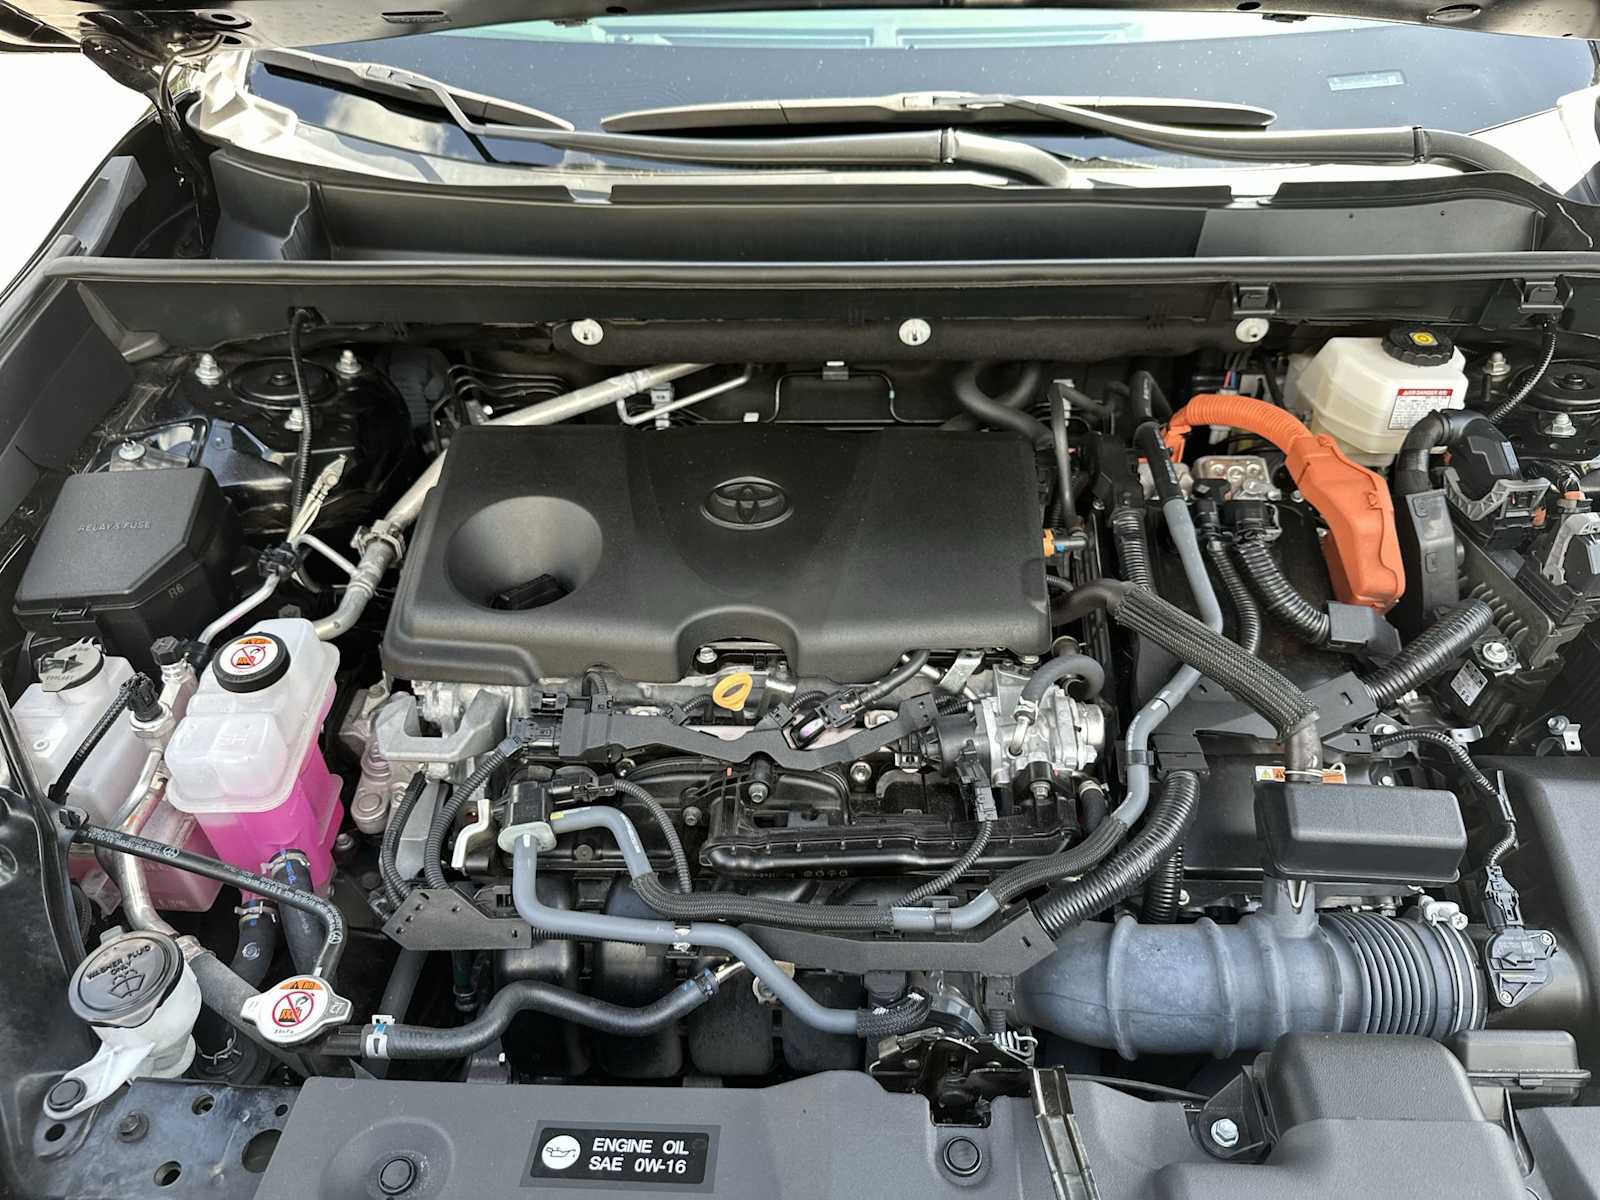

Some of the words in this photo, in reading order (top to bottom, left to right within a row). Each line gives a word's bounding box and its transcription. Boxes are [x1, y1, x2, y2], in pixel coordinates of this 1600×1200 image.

[127, 945, 151, 960] FLUID
[110, 961, 132, 975] ONLY
[592, 1137, 653, 1154] ENGINE
[662, 1140, 689, 1155] OIL
[588, 1156, 624, 1171] SAE
[634, 1158, 687, 1174] 0W-16
